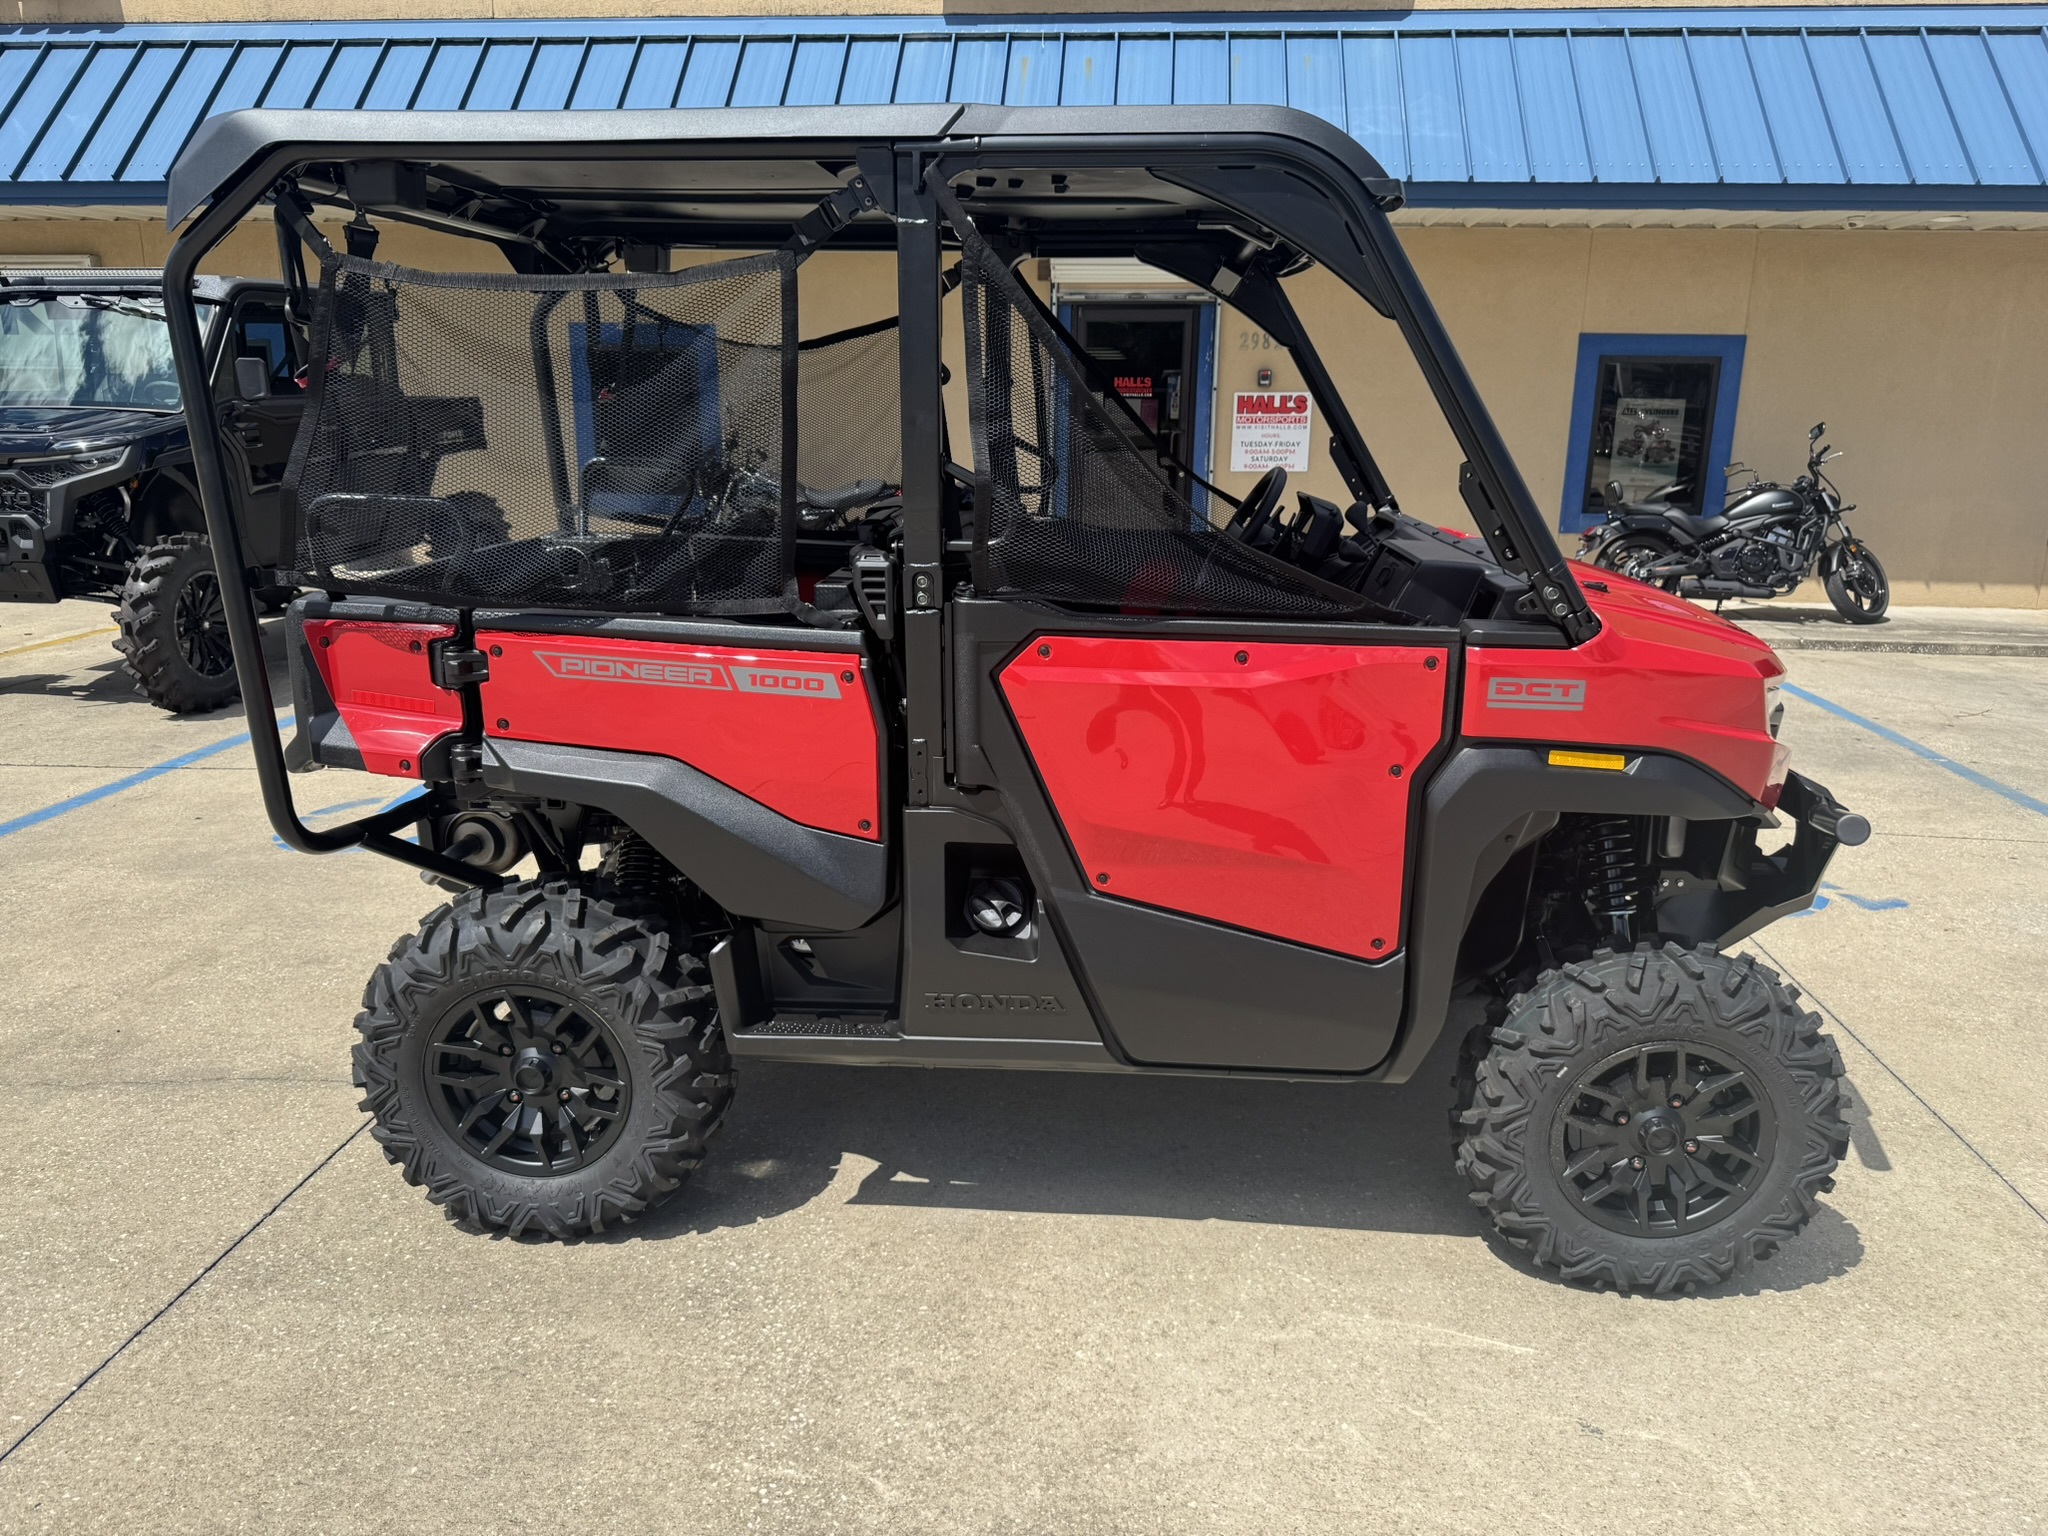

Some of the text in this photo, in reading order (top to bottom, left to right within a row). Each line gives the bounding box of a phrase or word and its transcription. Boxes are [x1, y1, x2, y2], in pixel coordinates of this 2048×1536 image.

[1114, 377, 1152, 388] HALL'S
[1236, 395, 1308, 415] HALL'S
[1237, 416, 1307, 424] MOTORSPORTS
[0, 491, 32, 506] TO
[560, 657, 824, 691] PIONEER 1000
[1495, 682, 1580, 698] DCT
[925, 992, 1067, 1012] HONDA
